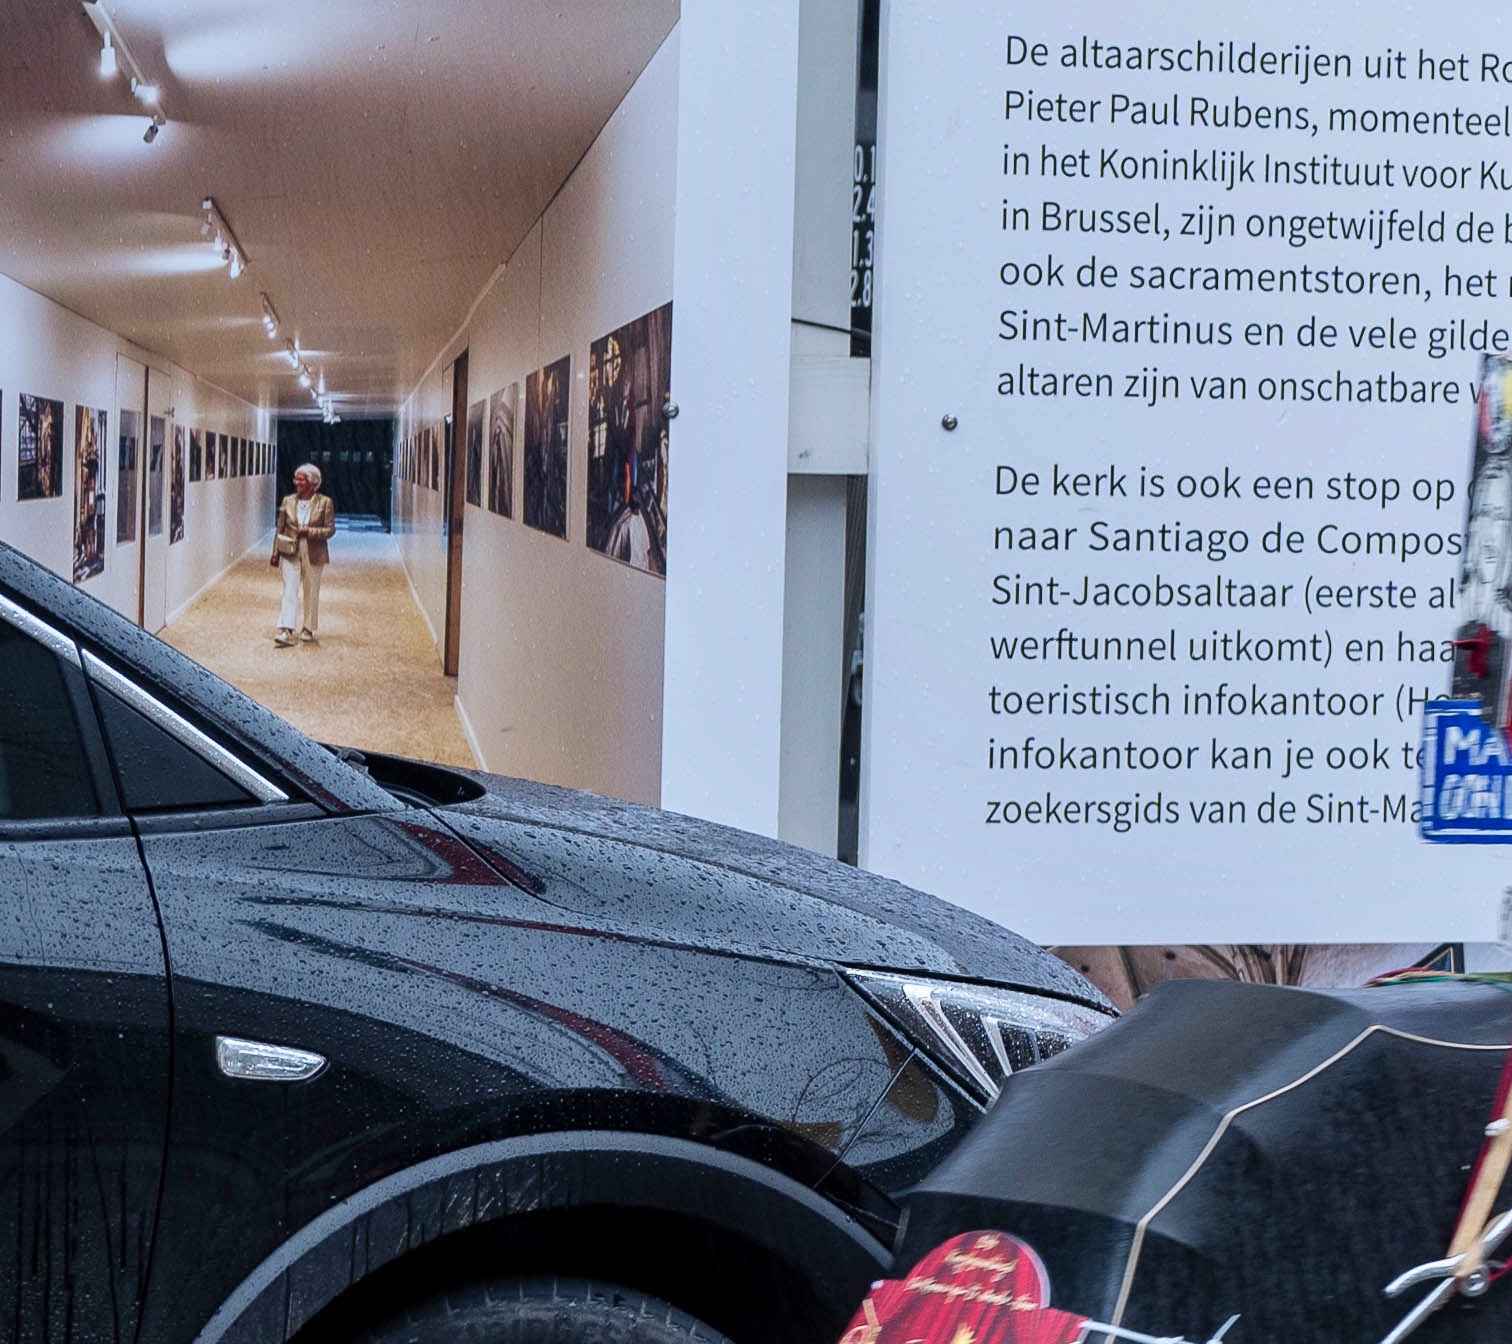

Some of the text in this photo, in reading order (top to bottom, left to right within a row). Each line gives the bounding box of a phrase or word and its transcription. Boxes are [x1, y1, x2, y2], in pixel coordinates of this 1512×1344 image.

[1007, 35, 1048, 67] De
[1061, 35, 1351, 85] altaarschilderijen
[1365, 48, 1406, 79] uit
[1418, 48, 1469, 82] het
[1005, 89, 1102, 123] Pieter
[1111, 93, 1179, 126] Paul
[1190, 96, 1318, 138] Rubens,
[1329, 105, 1510, 137] momenteel
[1004, 144, 1029, 176] in
[1041, 144, 1090, 178] het
[1100, 148, 1255, 191] Koninklijk
[1265, 153, 1395, 187] Instituut
[1402, 165, 1472, 189] voor
[1003, 199, 1029, 231] in
[1042, 201, 1170, 242] Brussel,
[1180, 204, 1234, 245] zijn
[1246, 209, 1445, 250] ongetwijfeld
[1456, 211, 1494, 244] de
[1000, 254, 1064, 287] ook
[1076, 255, 1118, 288] de
[1130, 264, 1431, 302] sacramentstoren,
[1445, 264, 1497, 297] het
[999, 309, 1232, 345] Sint-Martinus
[1245, 323, 1283, 346] en
[1297, 315, 1337, 347] de
[1348, 317, 1416, 349] vele
[998, 363, 1112, 397] altaren
[1124, 367, 1179, 407] zijn
[1190, 376, 1246, 399] van
[1258, 370, 1459, 404] onschatbare
[996, 465, 1039, 496] De
[1053, 464, 1127, 497] kerk
[1140, 475, 1165, 498] is
[1177, 466, 1241, 498] ook
[1253, 476, 1313, 499] een
[1326, 472, 1400, 509] stop
[1413, 479, 1454, 510] op
[995, 527, 1077, 551] naar
[1089, 521, 1248, 562] Santiago
[1262, 521, 1304, 554] de
[992, 573, 1294, 607] Sint-Jacobsaltaar
[1305, 575, 1416, 615] (eerste
[990, 628, 1176, 661] werftunnel
[1190, 629, 1332, 669] uitkomt)
[1345, 639, 1383, 662] en
[988, 683, 1169, 715] toeristisch
[1184, 683, 1384, 716] infokantoor
[989, 736, 1199, 770] infokantoor
[1211, 737, 1271, 770] kan
[1281, 747, 1314, 778] je
[1326, 738, 1390, 770] ook
[985, 792, 1179, 833] zoekersgids
[1189, 801, 1245, 824] van
[1257, 791, 1296, 823] de
